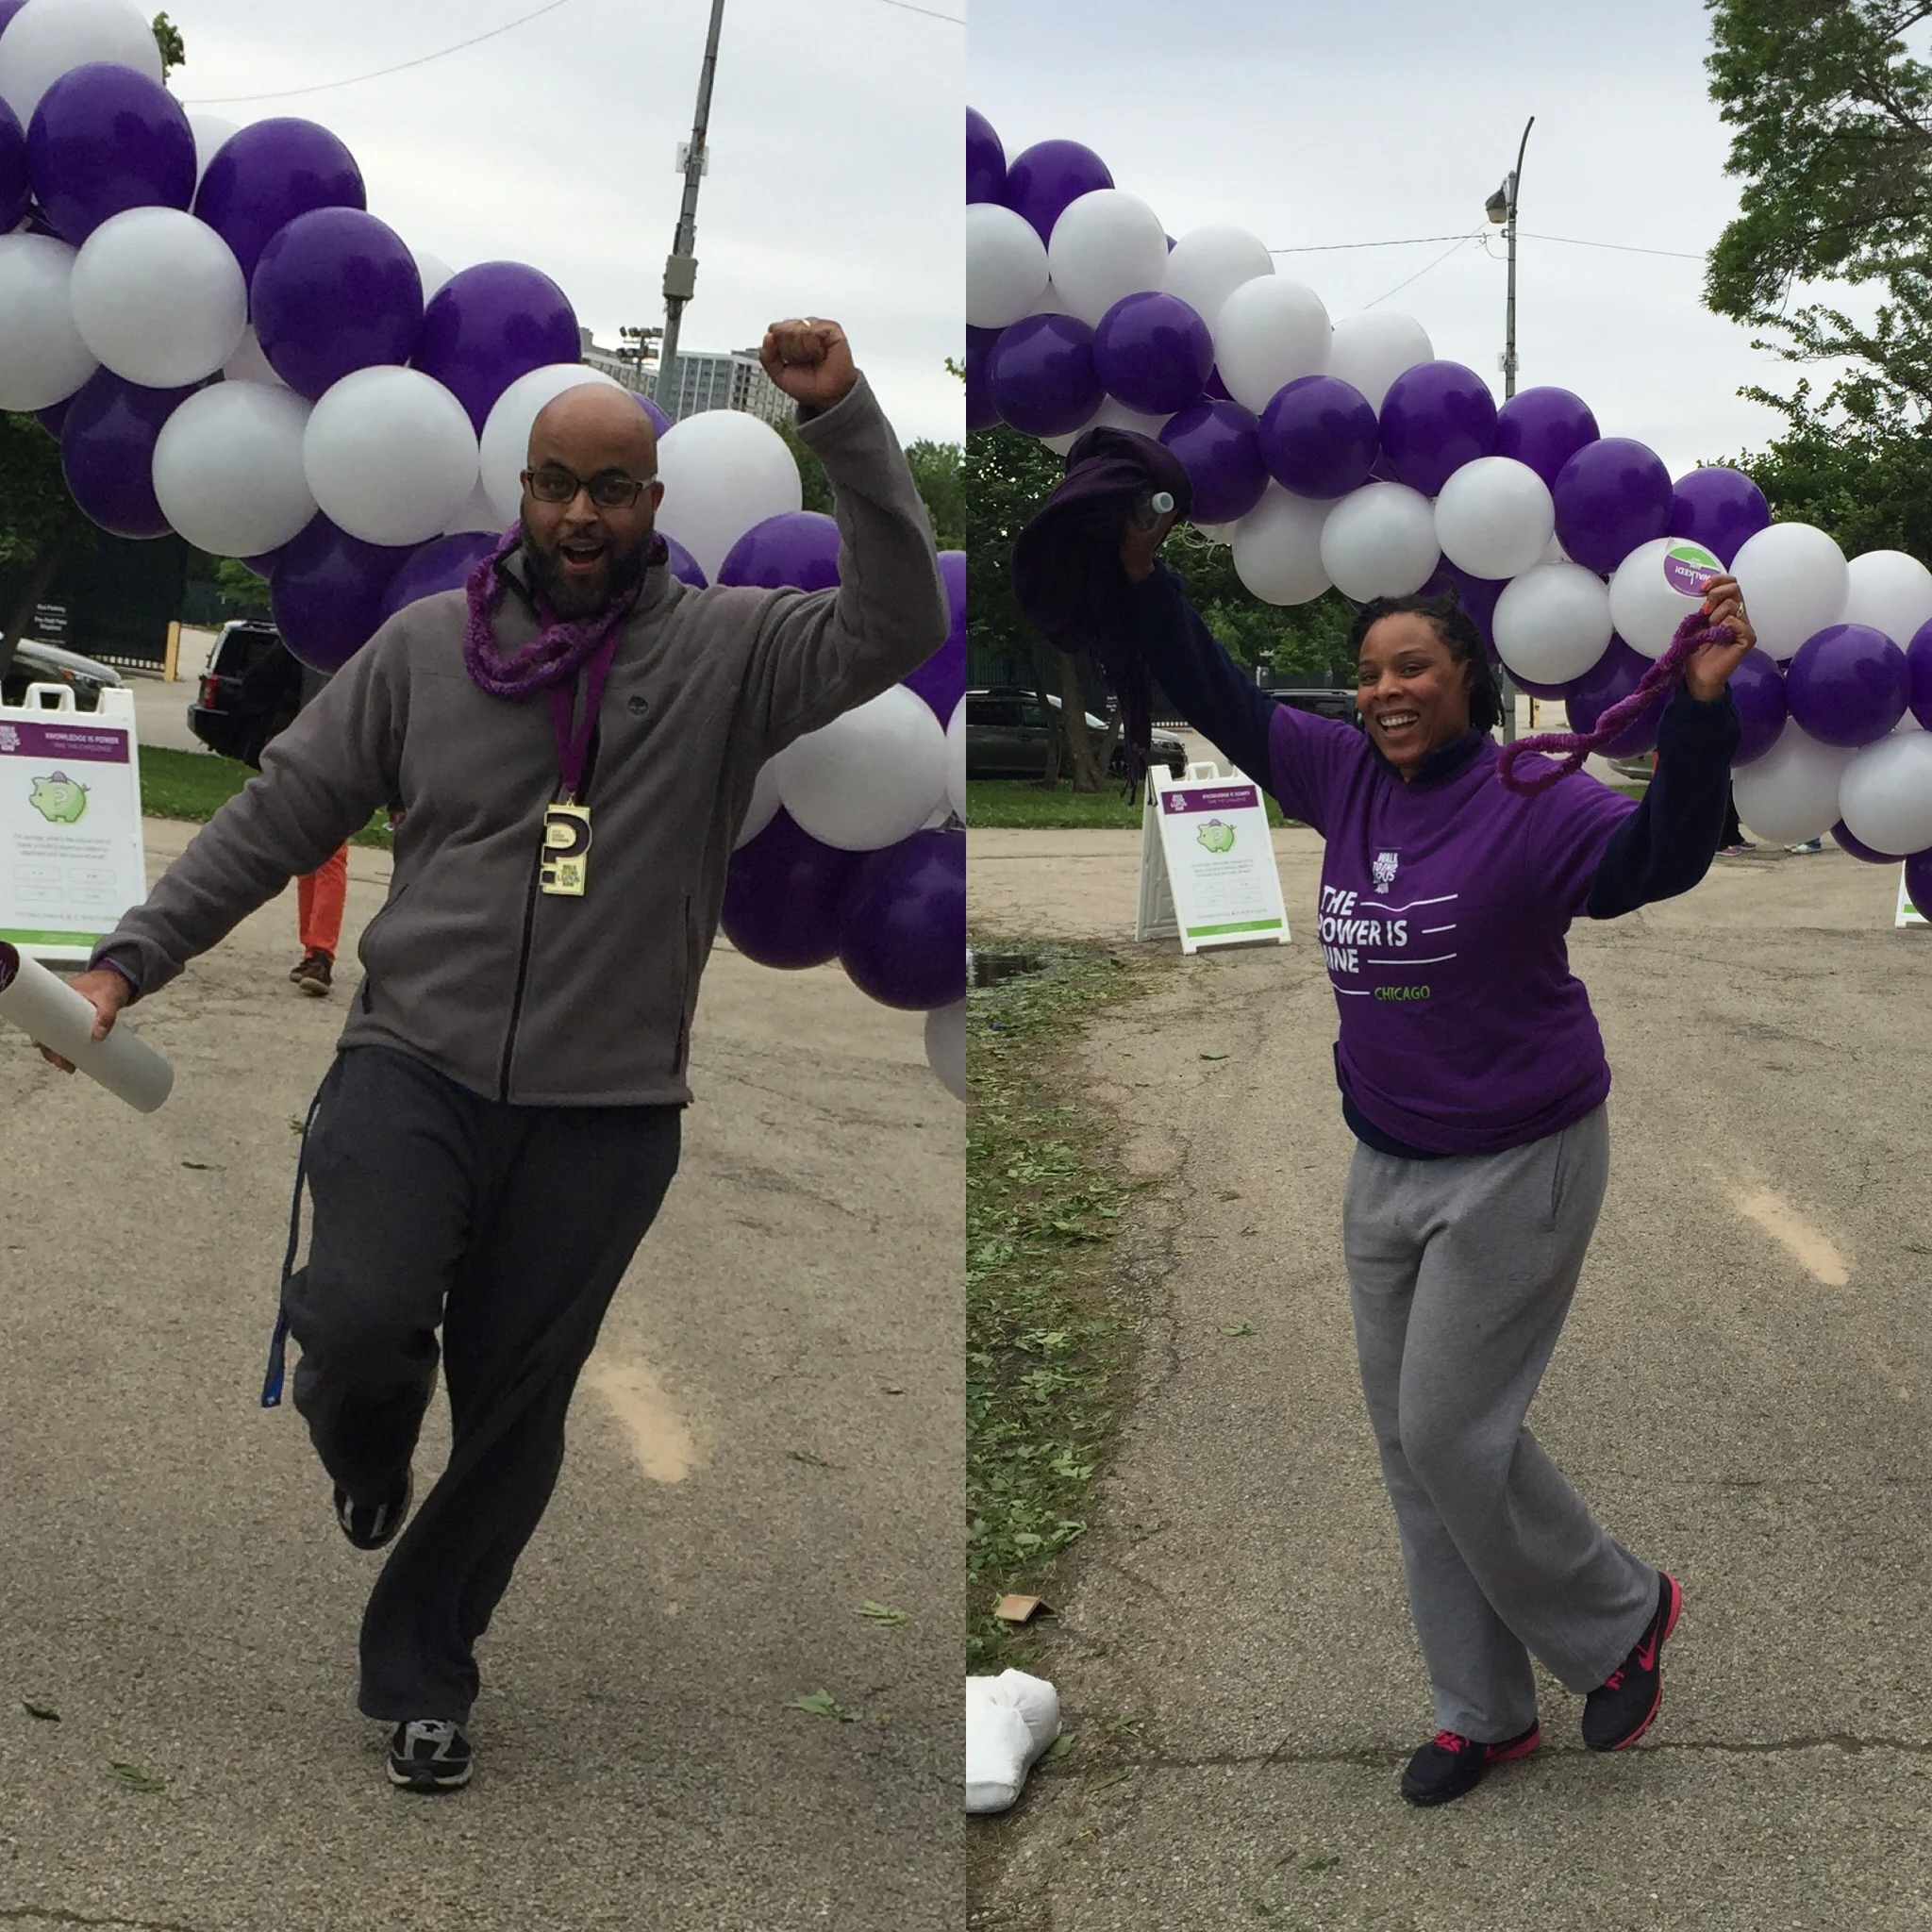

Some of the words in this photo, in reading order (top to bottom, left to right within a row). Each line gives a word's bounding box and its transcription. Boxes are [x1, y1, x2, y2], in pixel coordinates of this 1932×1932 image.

[44, 732, 87, 742] KNOWLEDGE
[95, 736, 120, 745] POWER
[1321, 885, 1358, 916] THE
[1386, 919, 1408, 947] IS
[1323, 944, 1359, 974] INE
[1374, 985, 1431, 1001] CHICAGO
